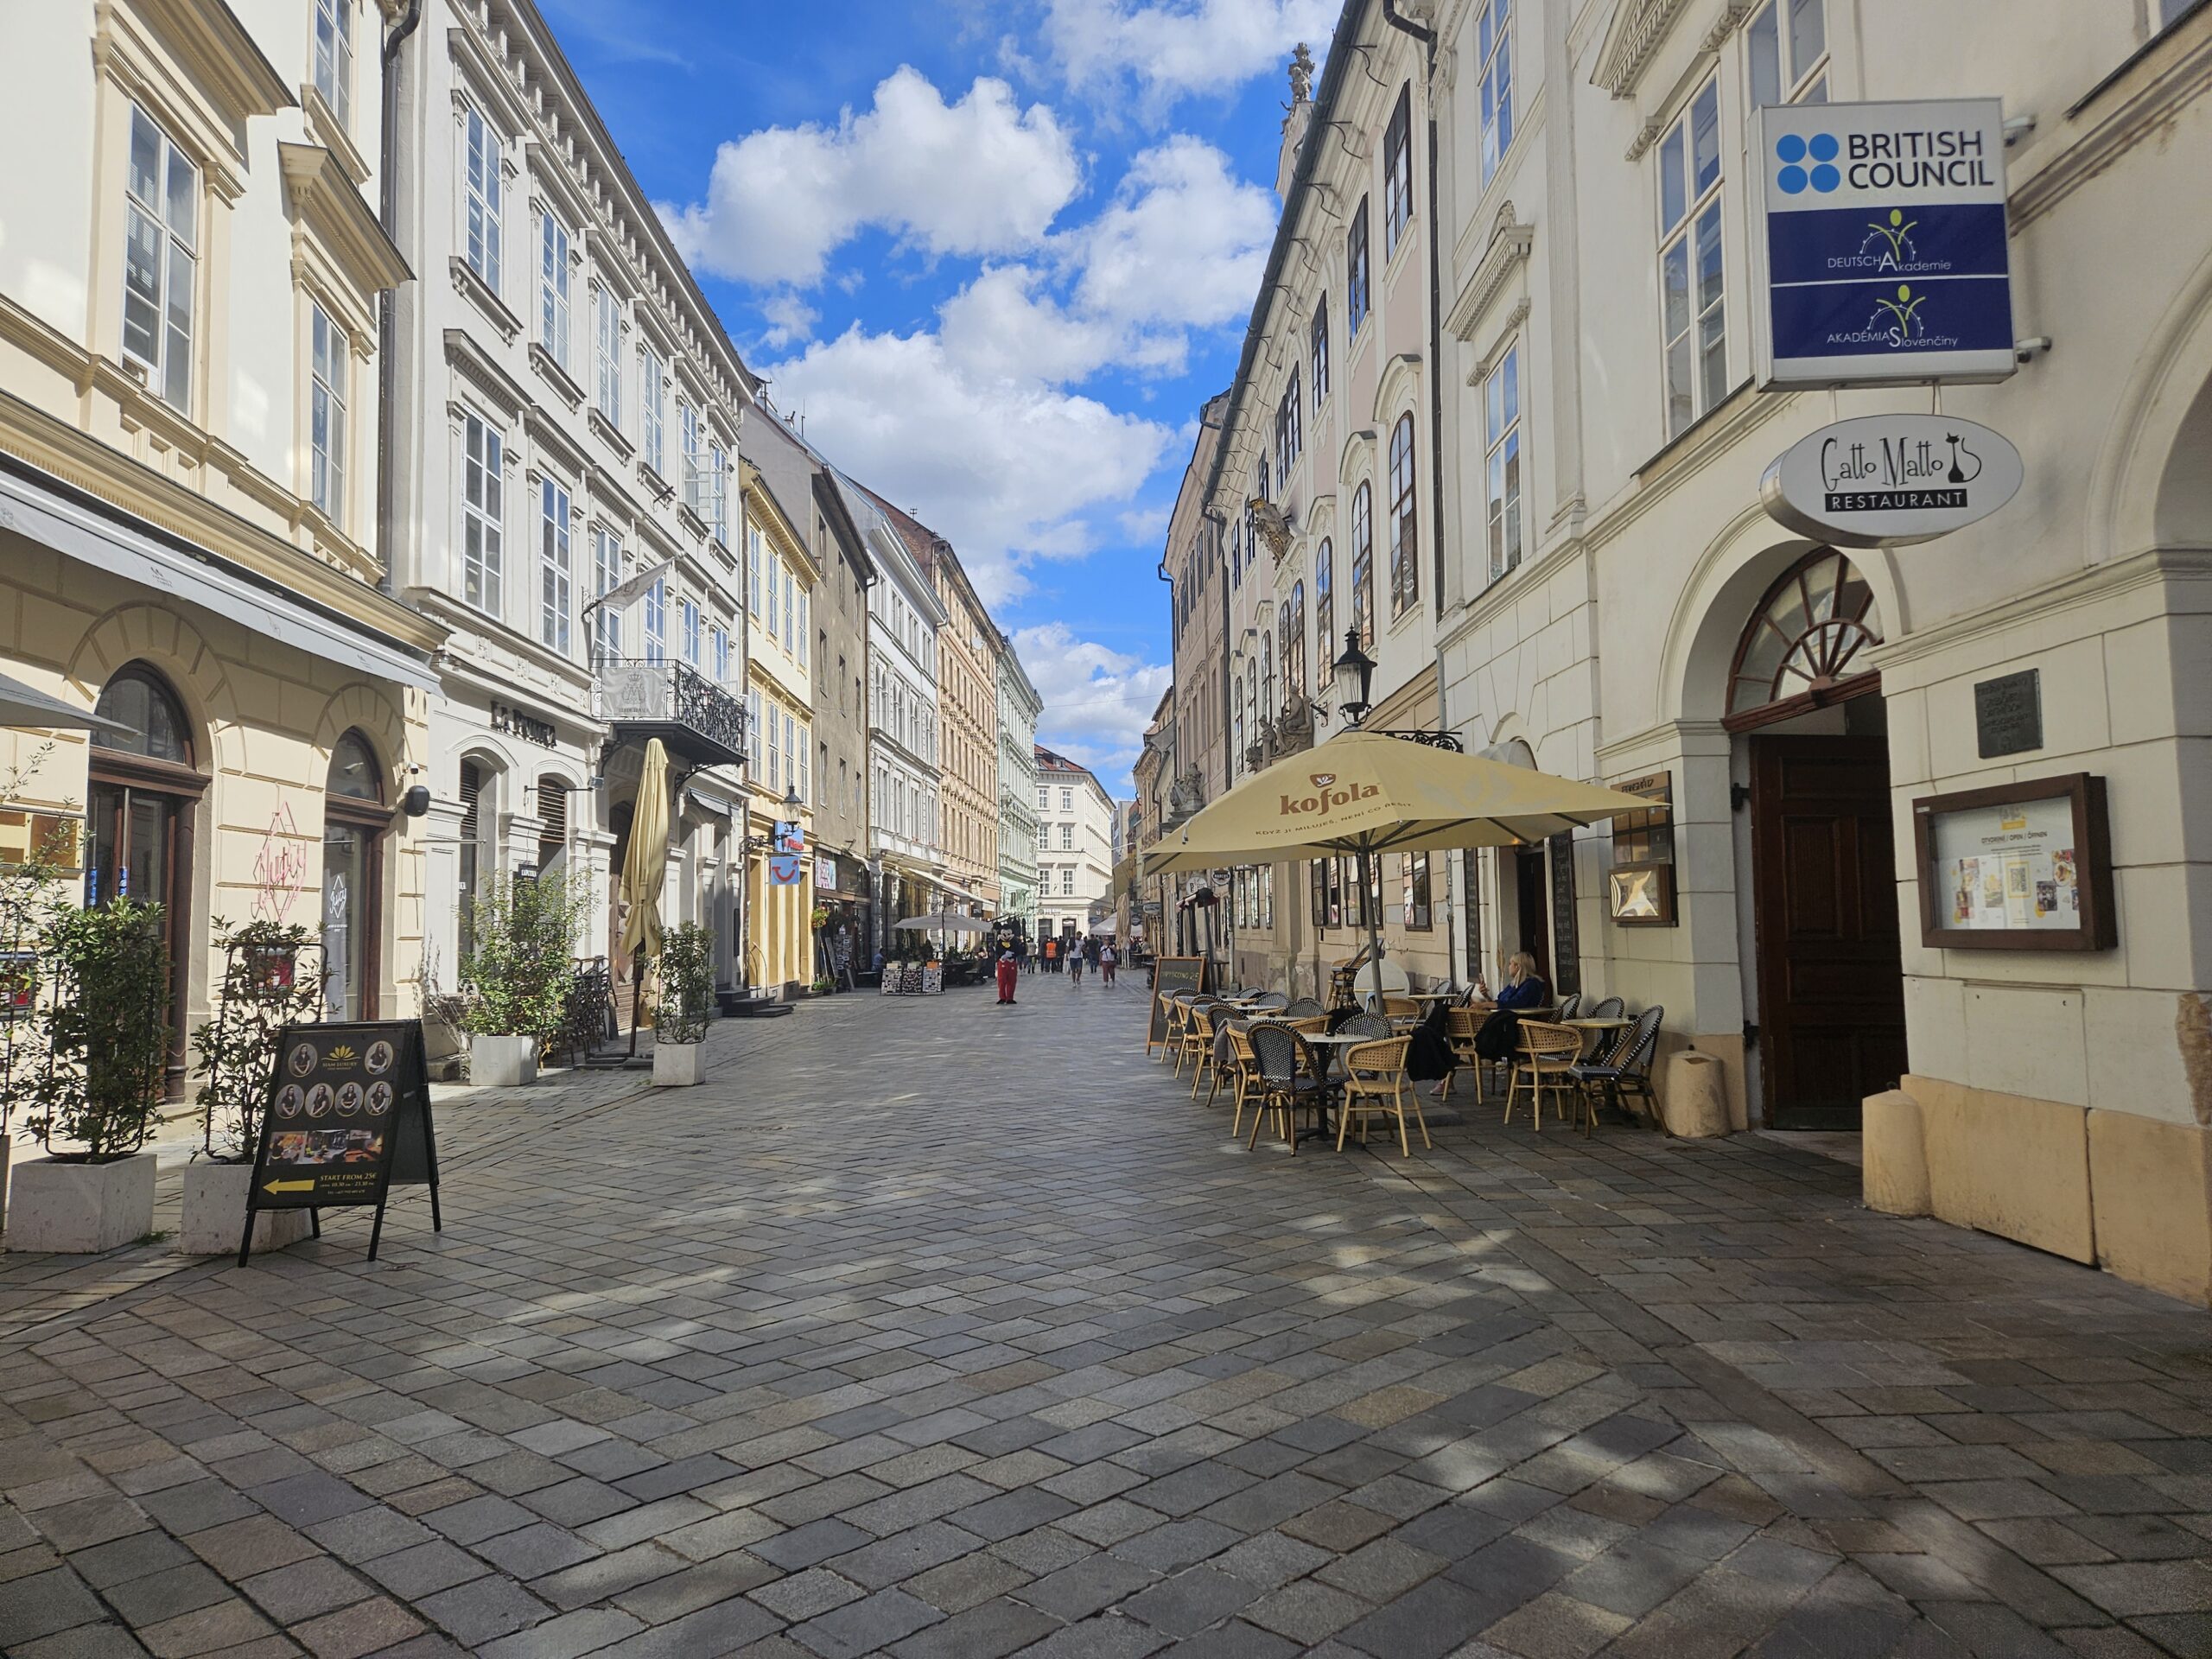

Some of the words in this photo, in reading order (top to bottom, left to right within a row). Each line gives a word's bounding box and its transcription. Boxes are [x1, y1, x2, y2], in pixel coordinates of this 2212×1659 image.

[1847, 130, 1982, 160] BRITISH
[1847, 159, 1995, 189] COUNCIL
[1827, 251, 1952, 272] DEUTSCHAkademie
[1827, 327, 1958, 347] AKADÉMIASlovenčiny
[1821, 436, 1877, 492] Gatto
[1878, 436, 1943, 489] Matto
[1832, 492, 1962, 510] RESTAURANT
[1280, 782, 1380, 816] kofola
